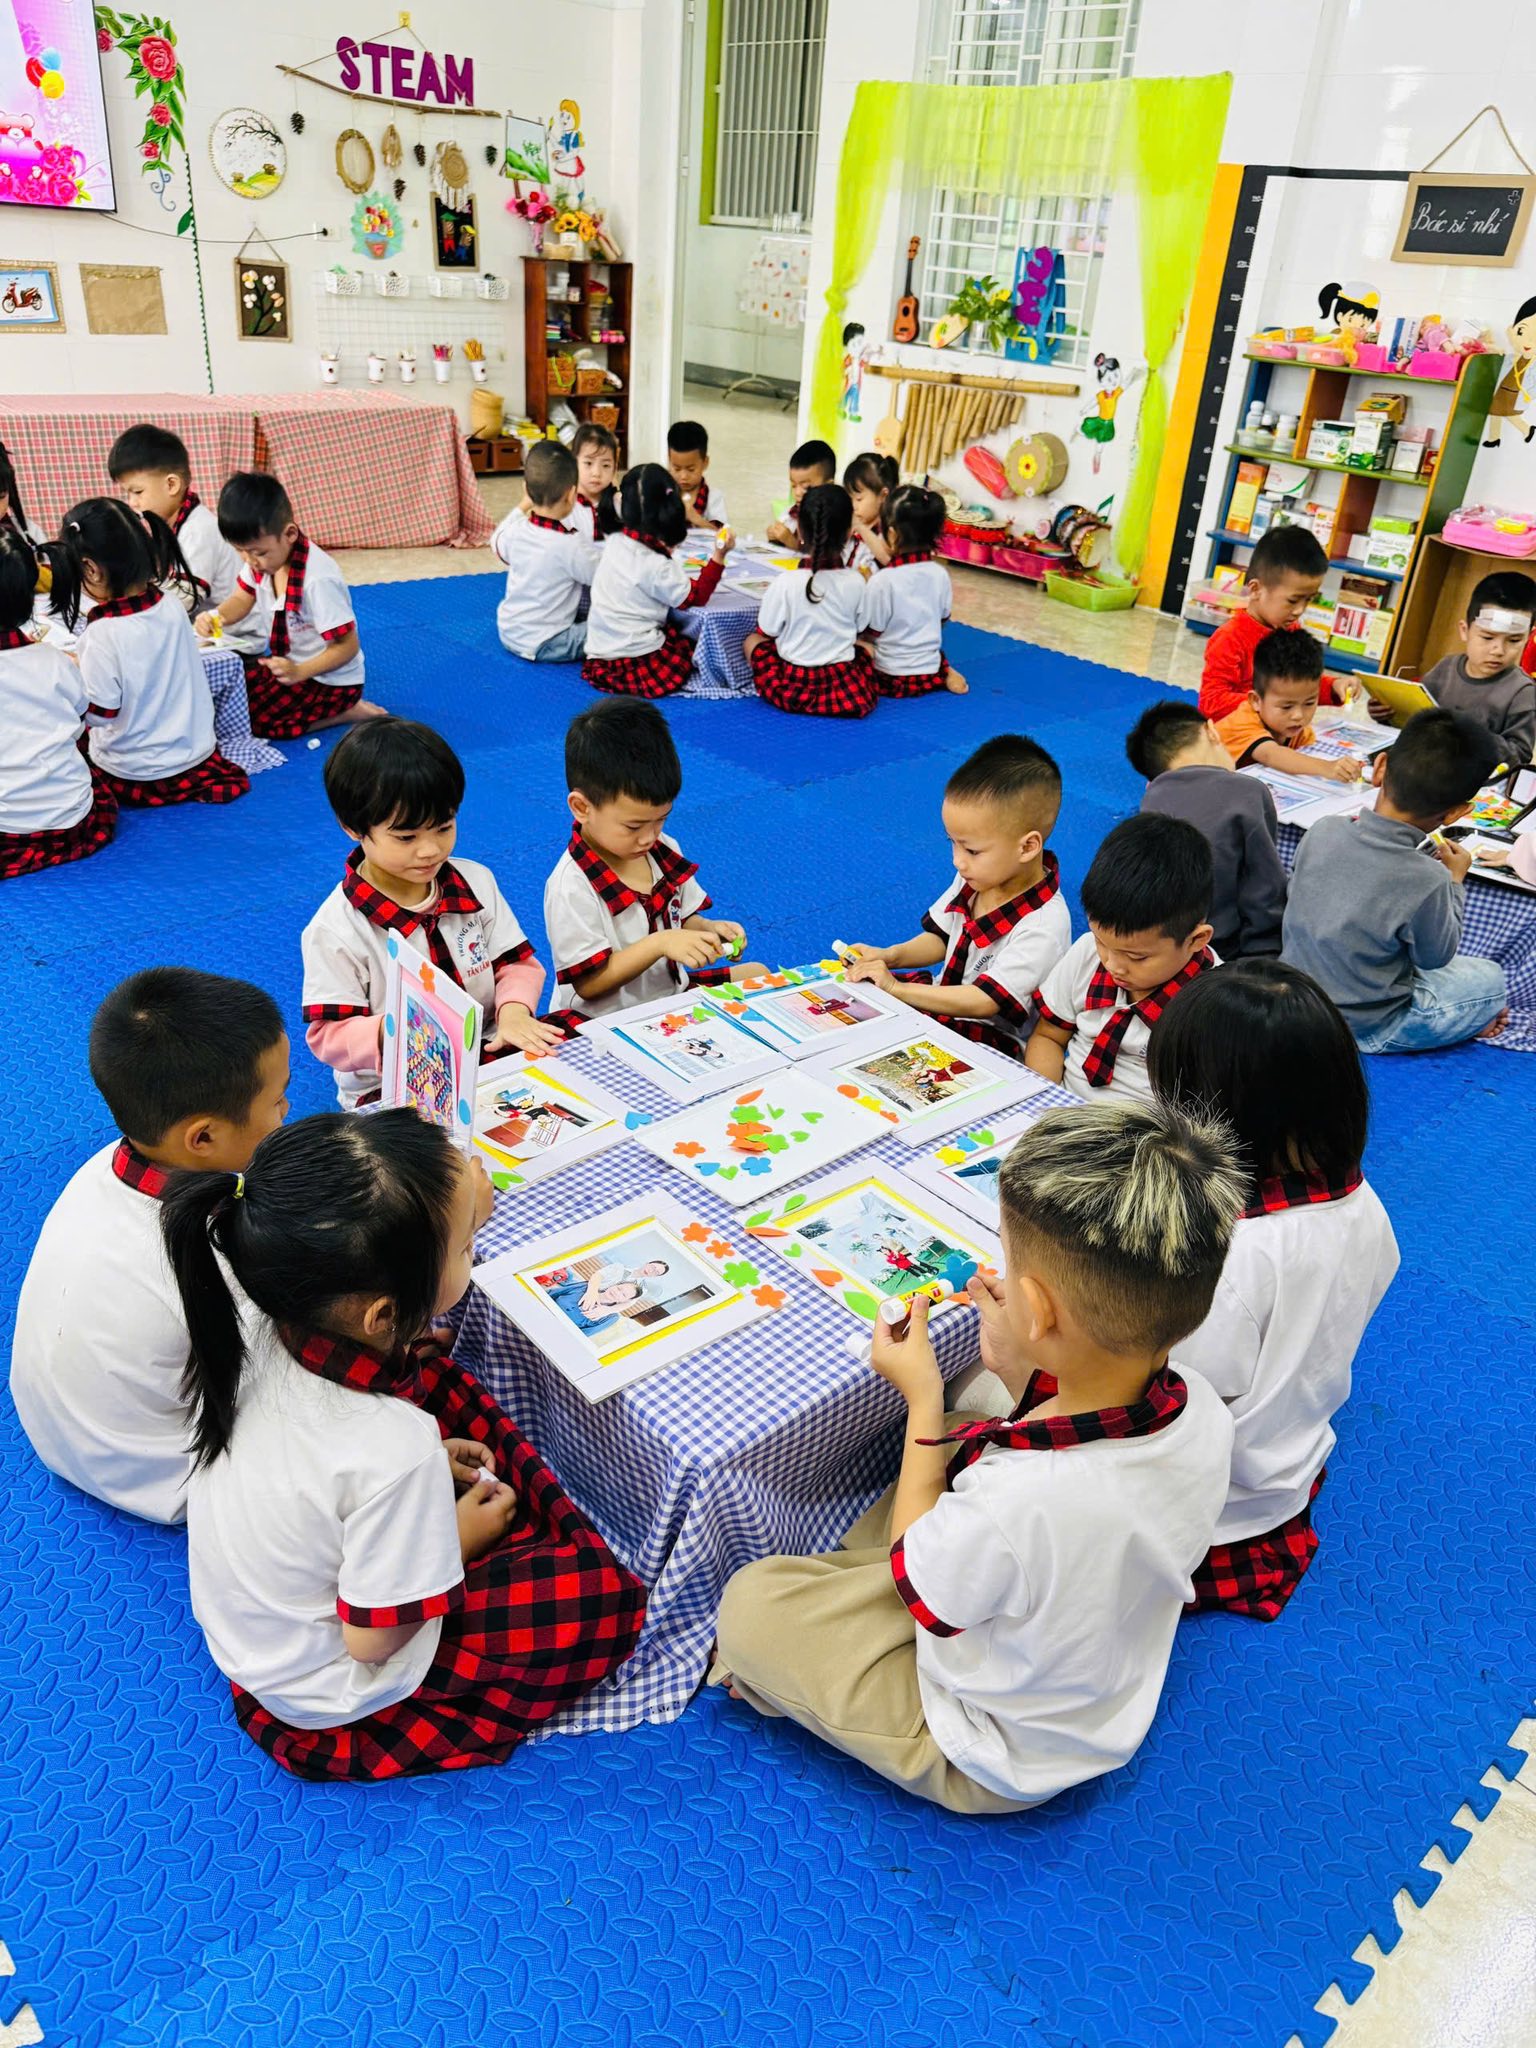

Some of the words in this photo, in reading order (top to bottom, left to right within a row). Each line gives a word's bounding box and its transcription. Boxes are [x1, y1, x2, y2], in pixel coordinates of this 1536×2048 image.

[336, 36, 474, 106] STEAM
[1410, 202, 1448, 231] Bác
[1447, 209, 1477, 233] sĩ
[1471, 207, 1510, 235] nhí
